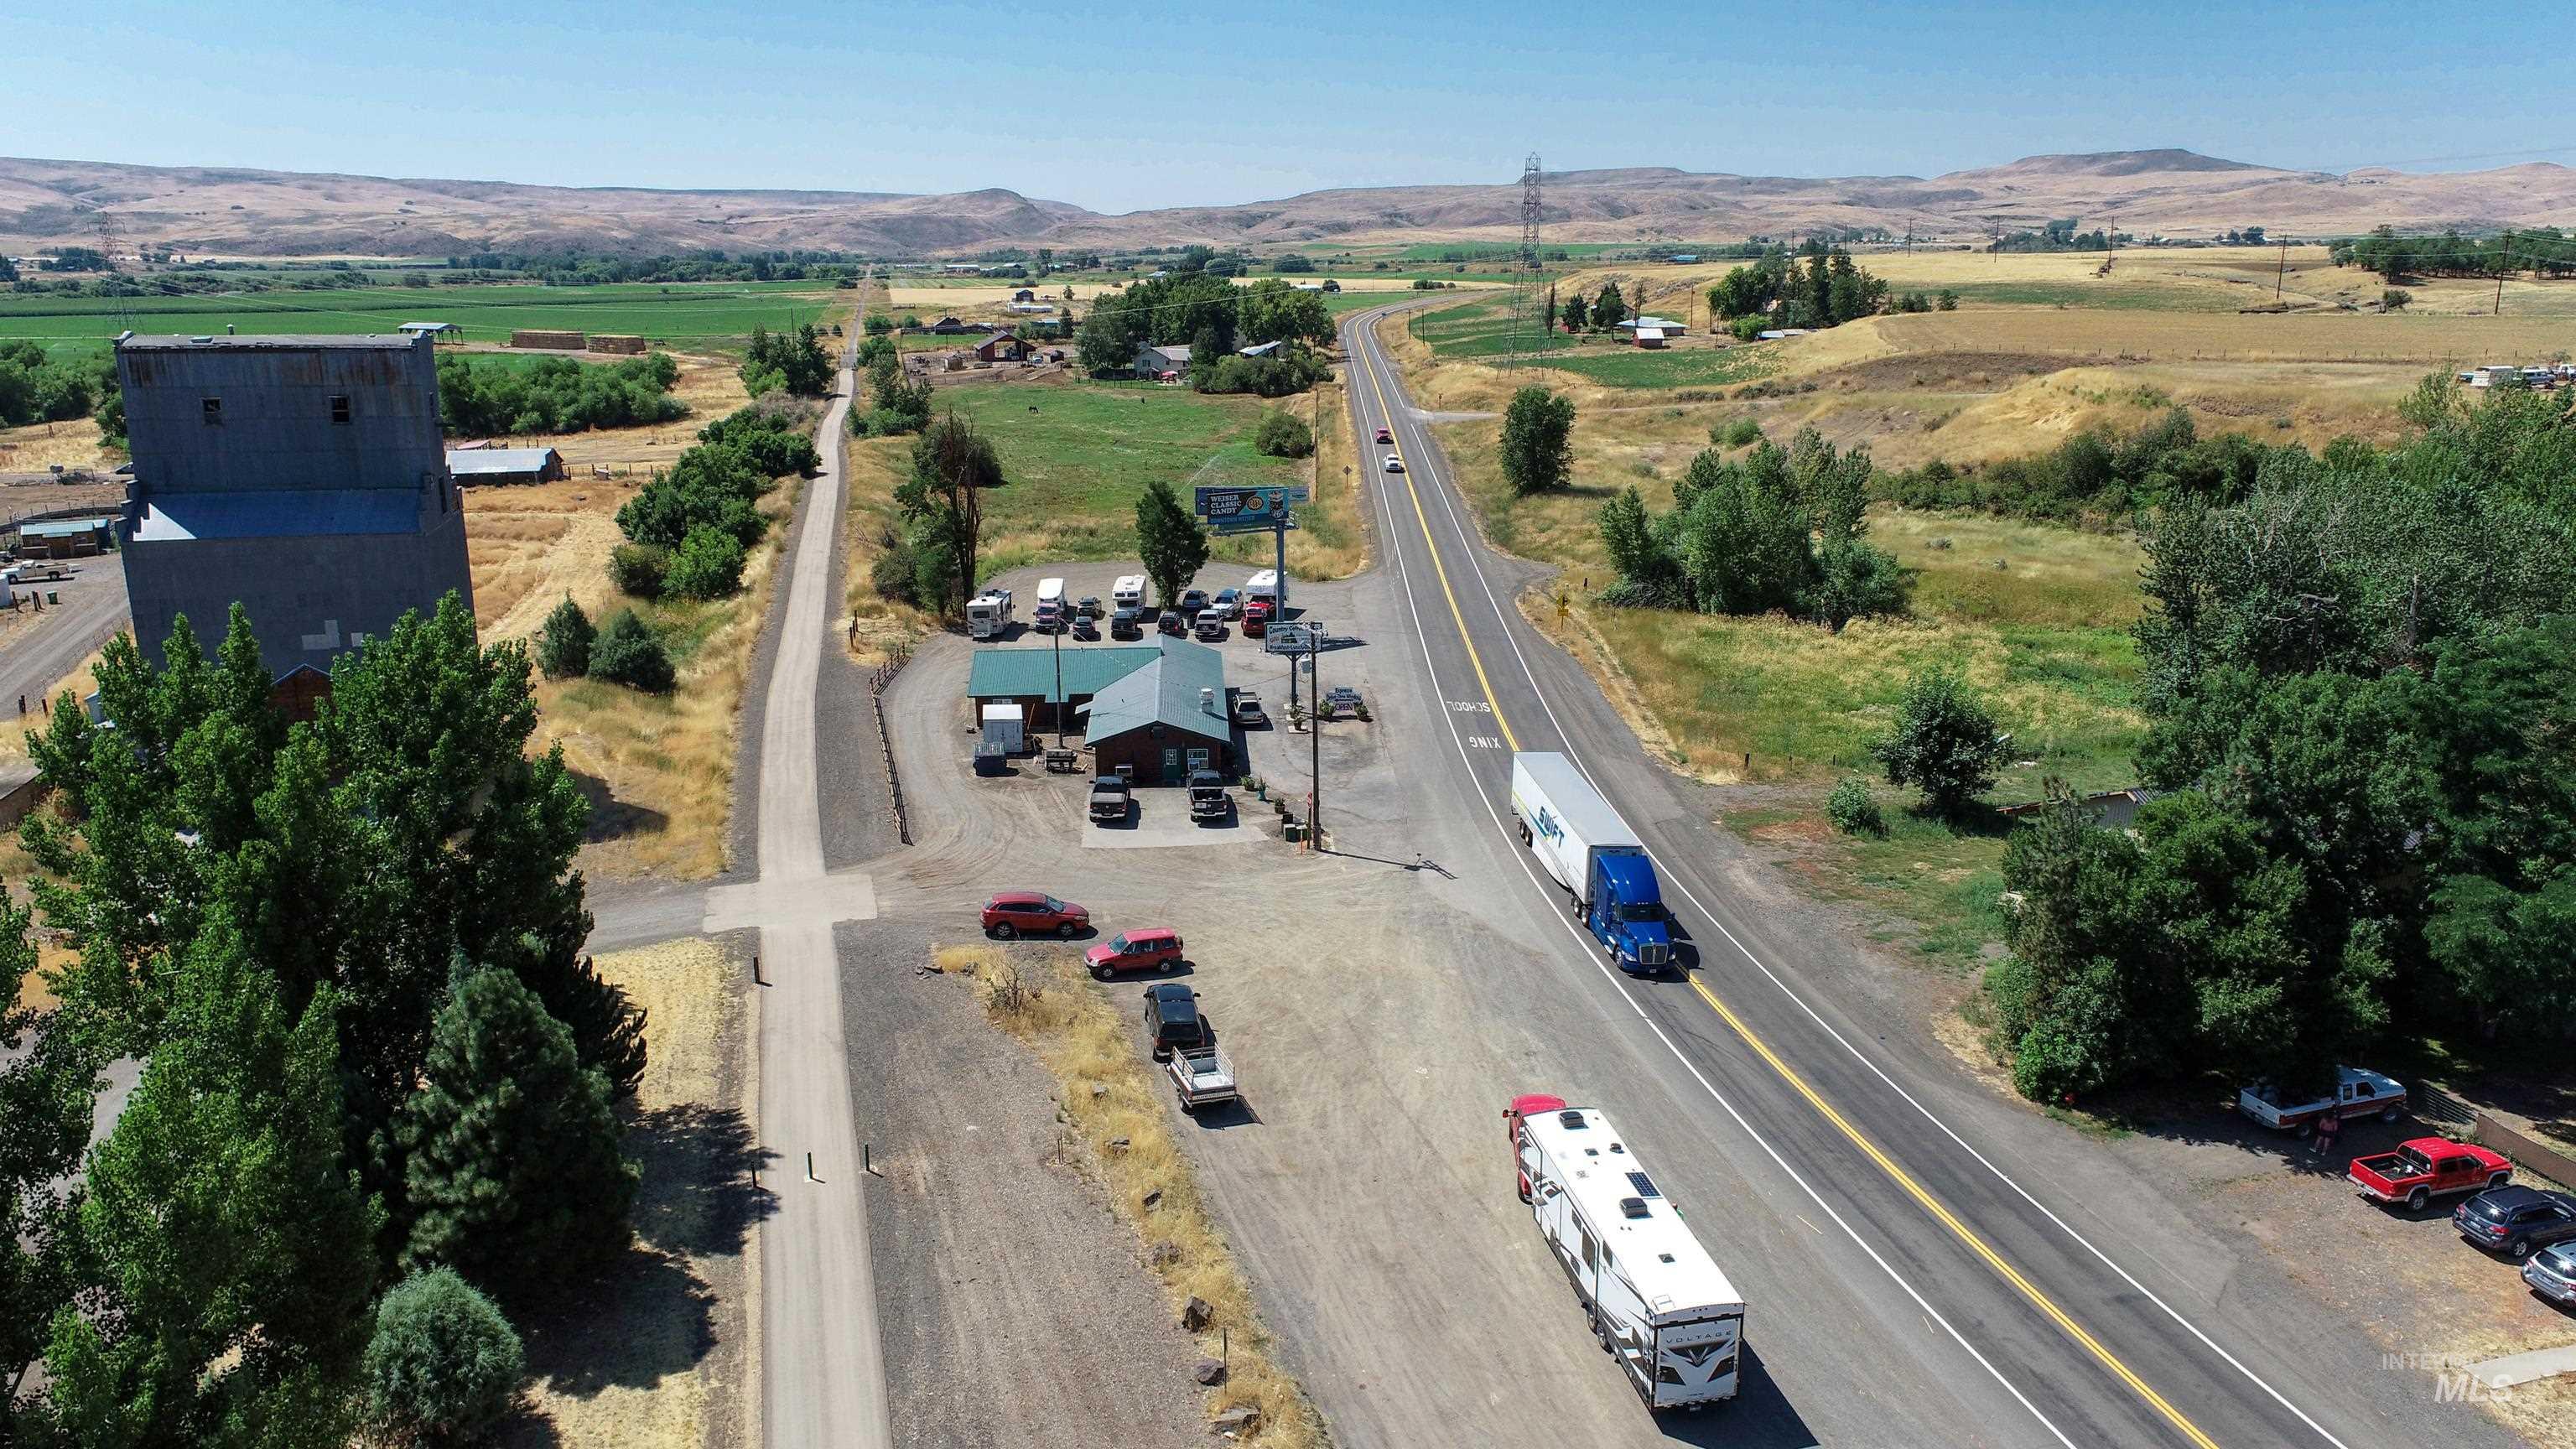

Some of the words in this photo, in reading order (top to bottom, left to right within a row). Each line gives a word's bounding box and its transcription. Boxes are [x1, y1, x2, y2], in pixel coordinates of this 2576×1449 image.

[1210, 501, 1242, 509] CLASSIC
[1446, 701, 1490, 712] SCHOOL
[1469, 736, 1502, 749] XING
[1539, 806, 1565, 849] SWIFT
[1666, 1330, 1732, 1343] VOLTAGE
